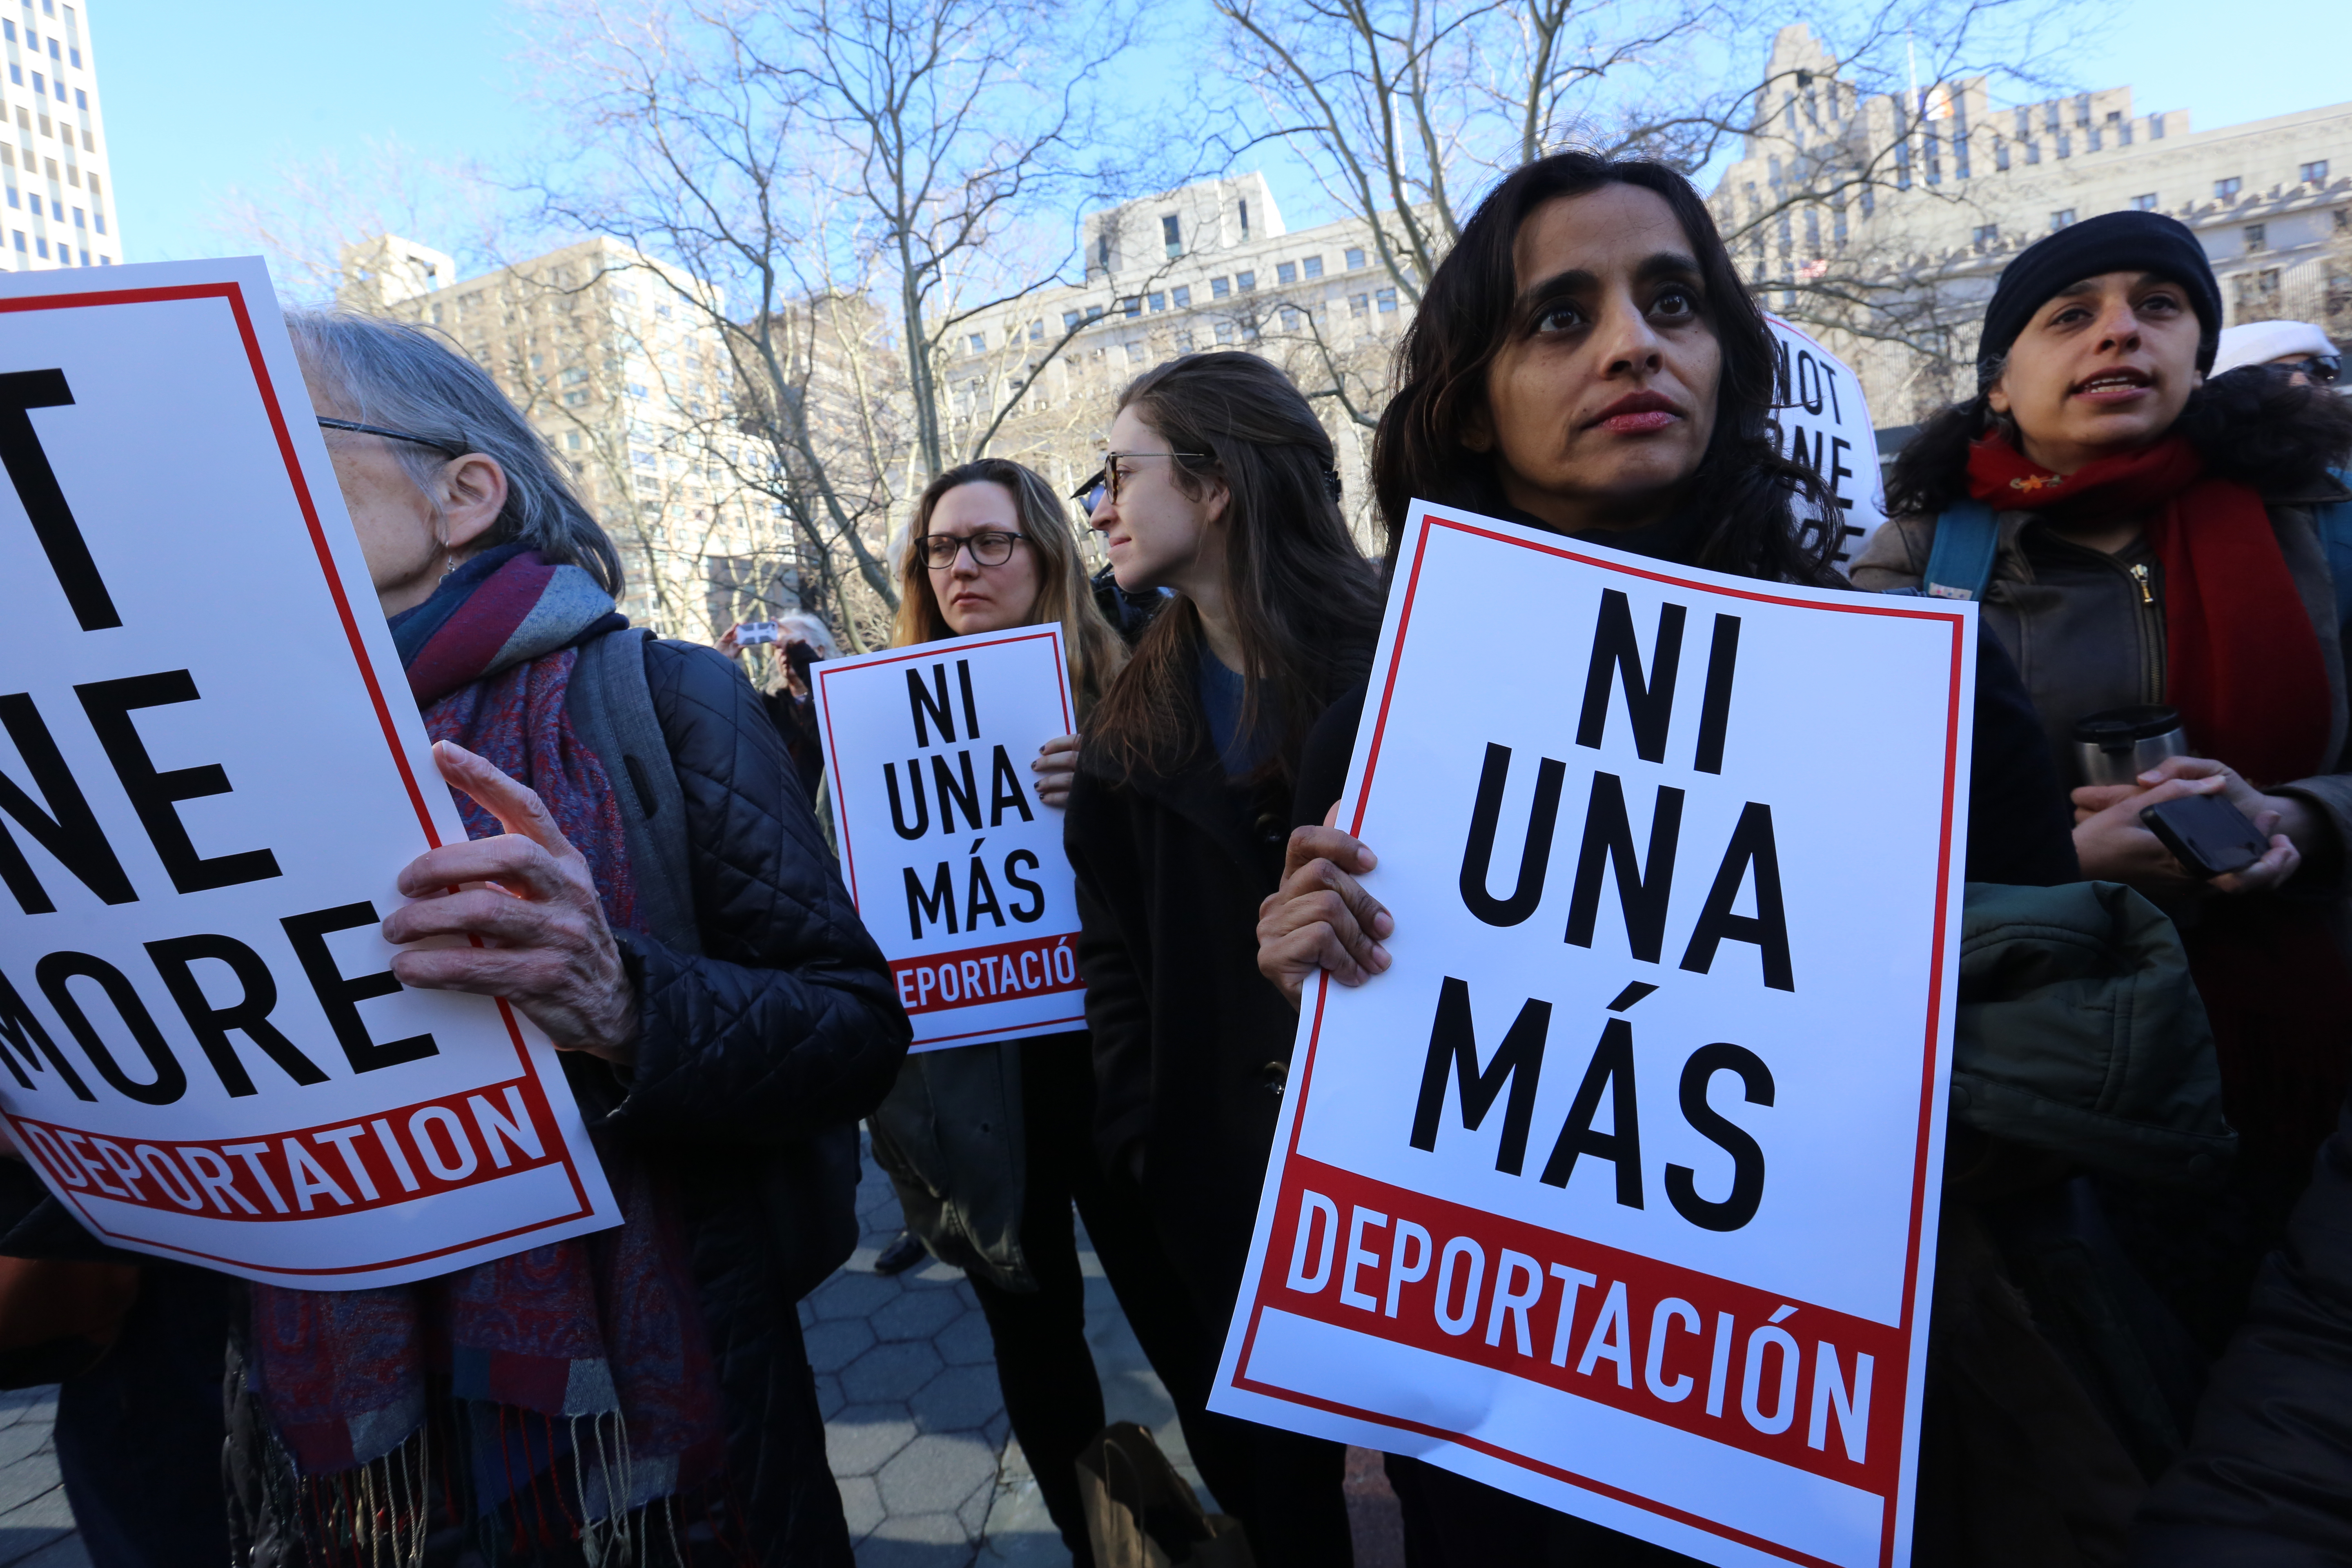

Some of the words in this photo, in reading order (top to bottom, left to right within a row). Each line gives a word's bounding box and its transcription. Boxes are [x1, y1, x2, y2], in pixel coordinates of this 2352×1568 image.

[906, 659, 980, 748] NI
[1576, 588, 1741, 775] NI
[883, 744, 1035, 840] UNA
[903, 837, 1045, 940] MÁS
[1459, 742, 1795, 992] UNA
[897, 936, 1076, 1008] EPORTACIÓ
[19, 1086, 546, 1214] DEPORTATION
[1410, 976, 1775, 1232] MÁS
[1286, 1189, 1874, 1464] DEPORTACIÓN
